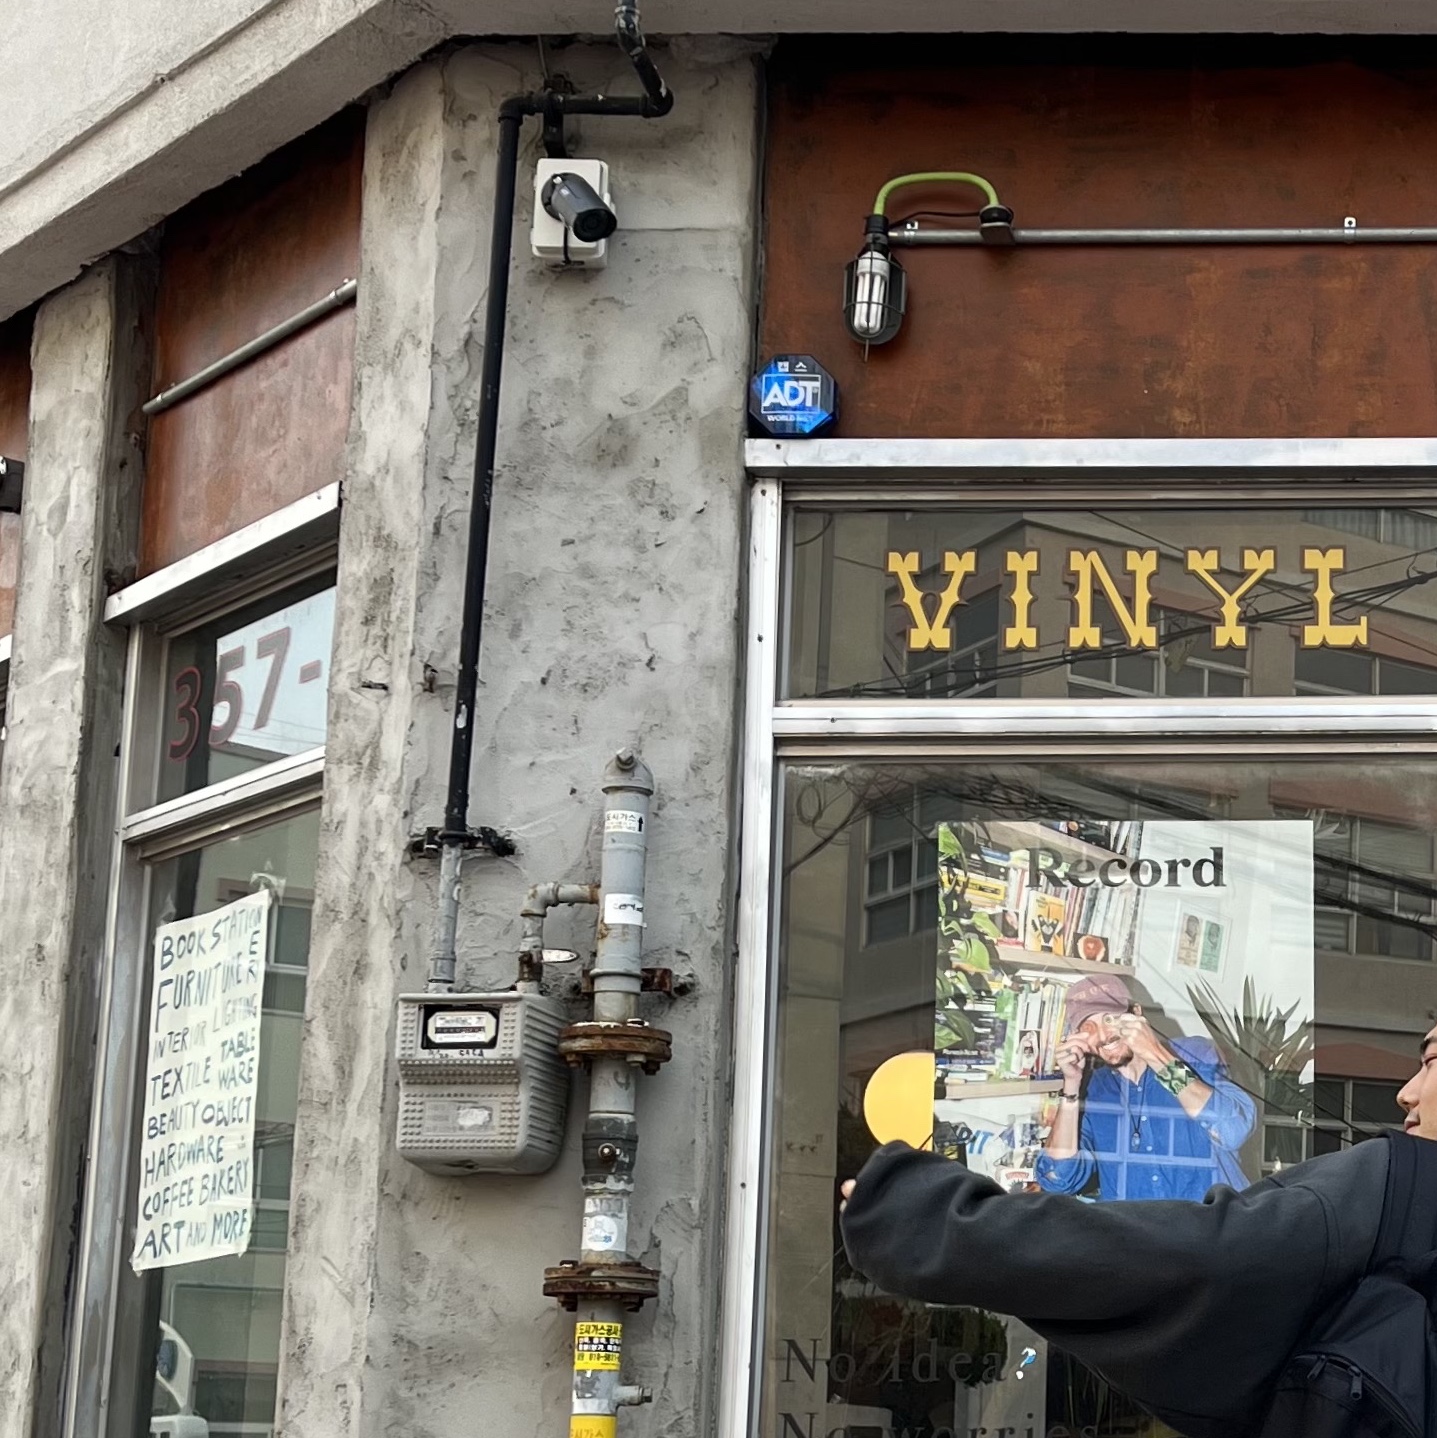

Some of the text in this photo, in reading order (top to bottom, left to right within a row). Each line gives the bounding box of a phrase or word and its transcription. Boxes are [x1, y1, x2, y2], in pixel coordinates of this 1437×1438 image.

[762, 380, 820, 407] ADT
[886, 545, 1370, 651] VINYL
[1026, 847, 1227, 888] Record
[160, 928, 206, 971] BOOK
[155, 952, 242, 1033] FURNITURE
[153, 1021, 207, 1063] INTERIOR
[151, 1057, 211, 1106] TEXTILE
[147, 1096, 251, 1140] BEAUTY OBJECT
[144, 1135, 225, 1188] HARDWARE
[142, 1157, 249, 1221] COFFEE BAKERY
[138, 1209, 248, 1259] ART AND MORE
[781, 1338, 856, 1383] No
